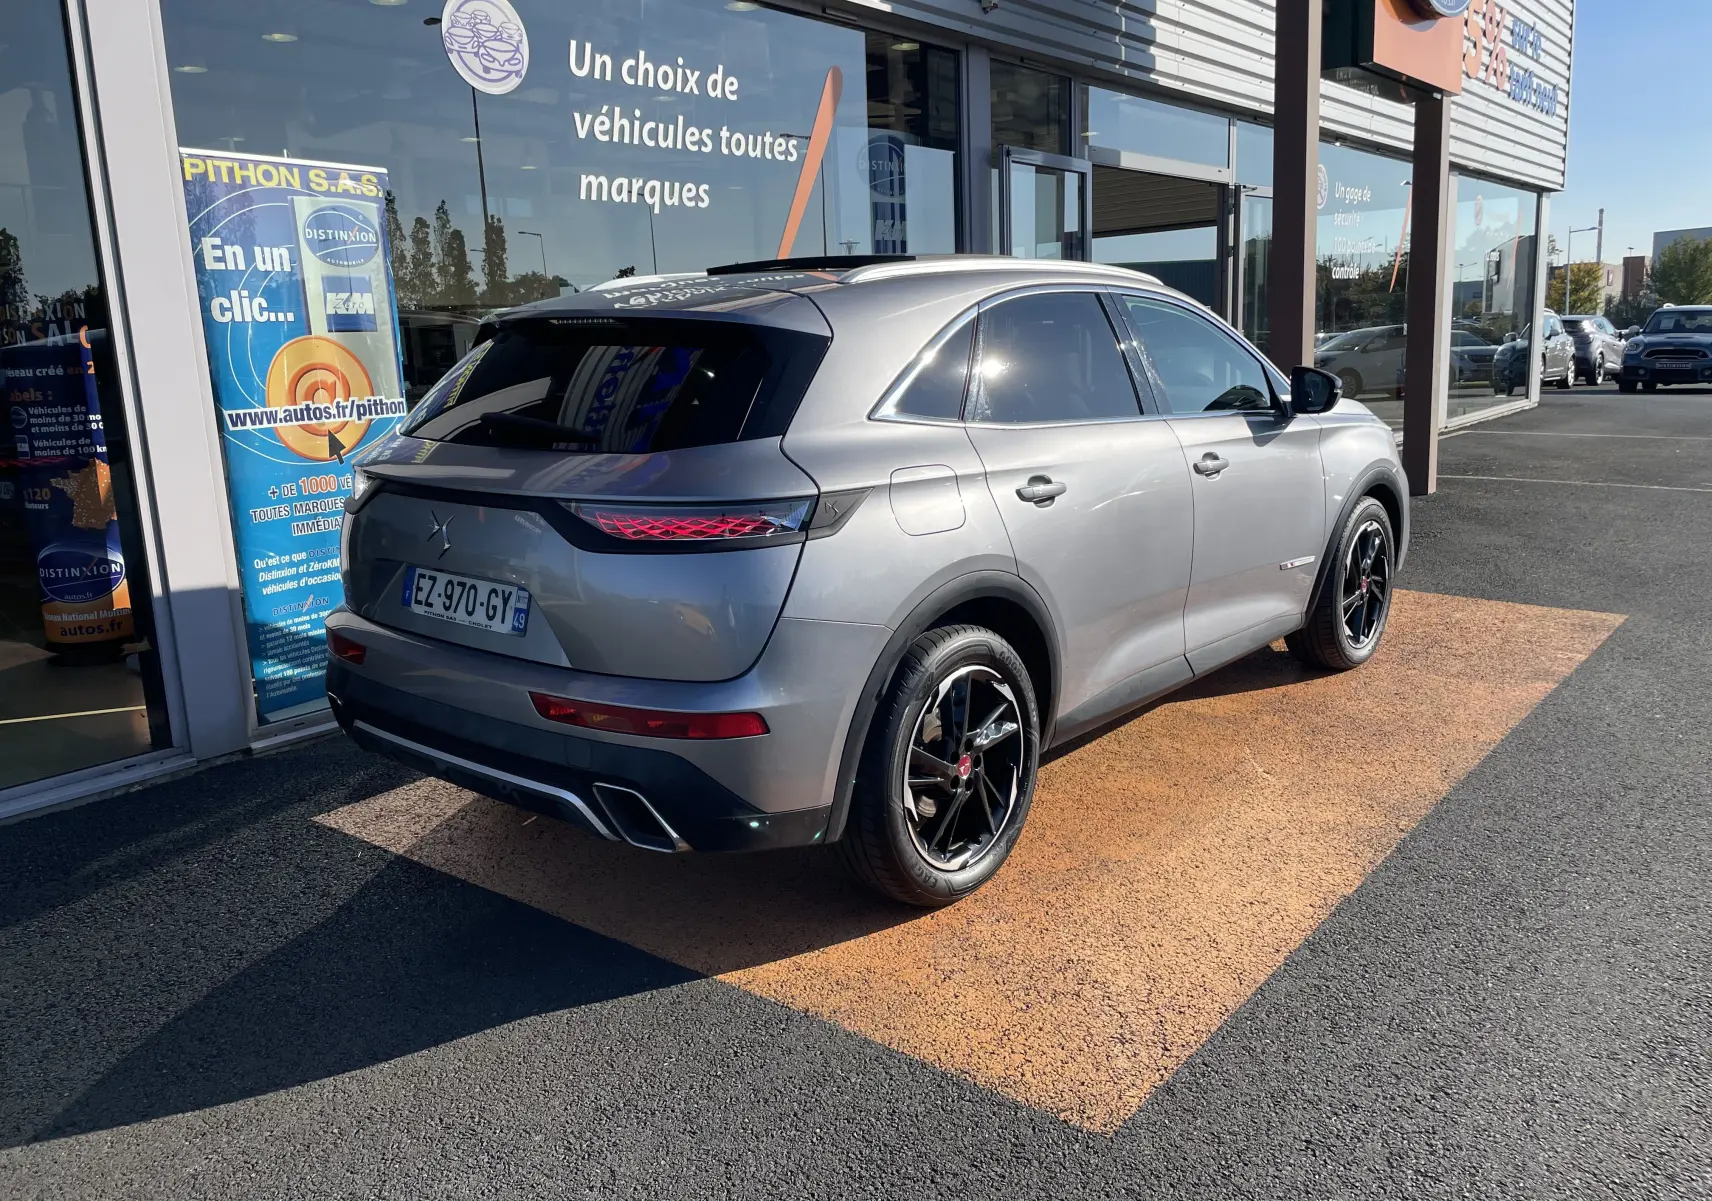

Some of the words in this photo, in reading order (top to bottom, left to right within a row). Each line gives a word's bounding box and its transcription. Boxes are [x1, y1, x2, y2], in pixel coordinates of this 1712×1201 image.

[1511, 17, 1532, 53] sur
[568, 38, 612, 81] Un
[621, 50, 701, 96] choix
[706, 64, 739, 101] de
[572, 106, 713, 154] véhicules
[719, 125, 799, 163] toutes
[183, 158, 301, 189] PITHON
[309, 169, 384, 198] S.A.S.
[579, 174, 711, 214] marques
[1335, 181, 1345, 199] Un
[1346, 187, 1362, 204] gage
[1363, 185, 1371, 202] de
[1334, 209, 1360, 227] sécurité
[305, 226, 377, 243] DISTINXION
[201, 237, 245, 271] En
[255, 245, 292, 273] un
[1332, 263, 1360, 280] contrôle
[210, 290, 295, 323] clic...
[36, 364, 64, 376] créé
[28, 405, 73, 415] Véhicules
[74, 404, 87, 412] de
[228, 398, 406, 428] www.autos.fr/pithon
[30, 415, 57, 424] moins
[58, 414, 71, 422] de
[41, 425, 69, 433] moins
[71, 423, 84, 431] de
[33, 438, 76, 447] Véhicules
[78, 437, 91, 445] de
[34, 449, 61, 457] moins
[62, 447, 76, 455] de
[282, 485, 297, 498] DE
[300, 475, 337, 496] 1000
[251, 504, 290, 523] TOUTES
[294, 497, 345, 516] MARQUES
[254, 556, 280, 569] Qu'est
[281, 555, 290, 564] ce
[292, 552, 307, 563] que
[39, 563, 121, 578] DISTINXION
[259, 567, 297, 582] Distinxion
[299, 564, 307, 573] et
[309, 558, 341, 572] ZéroKM
[64, 592, 93, 600] autos.fr
[262, 579, 298, 596] véhicules
[272, 598, 329, 616] DISTINXION
[62, 610, 98, 622] National
[423, 610, 445, 618] PITHON
[468, 620, 493, 629] CHOLET
[513, 612, 525, 629] 49
[61, 619, 123, 636] autos.fr
[297, 623, 311, 631] mois
